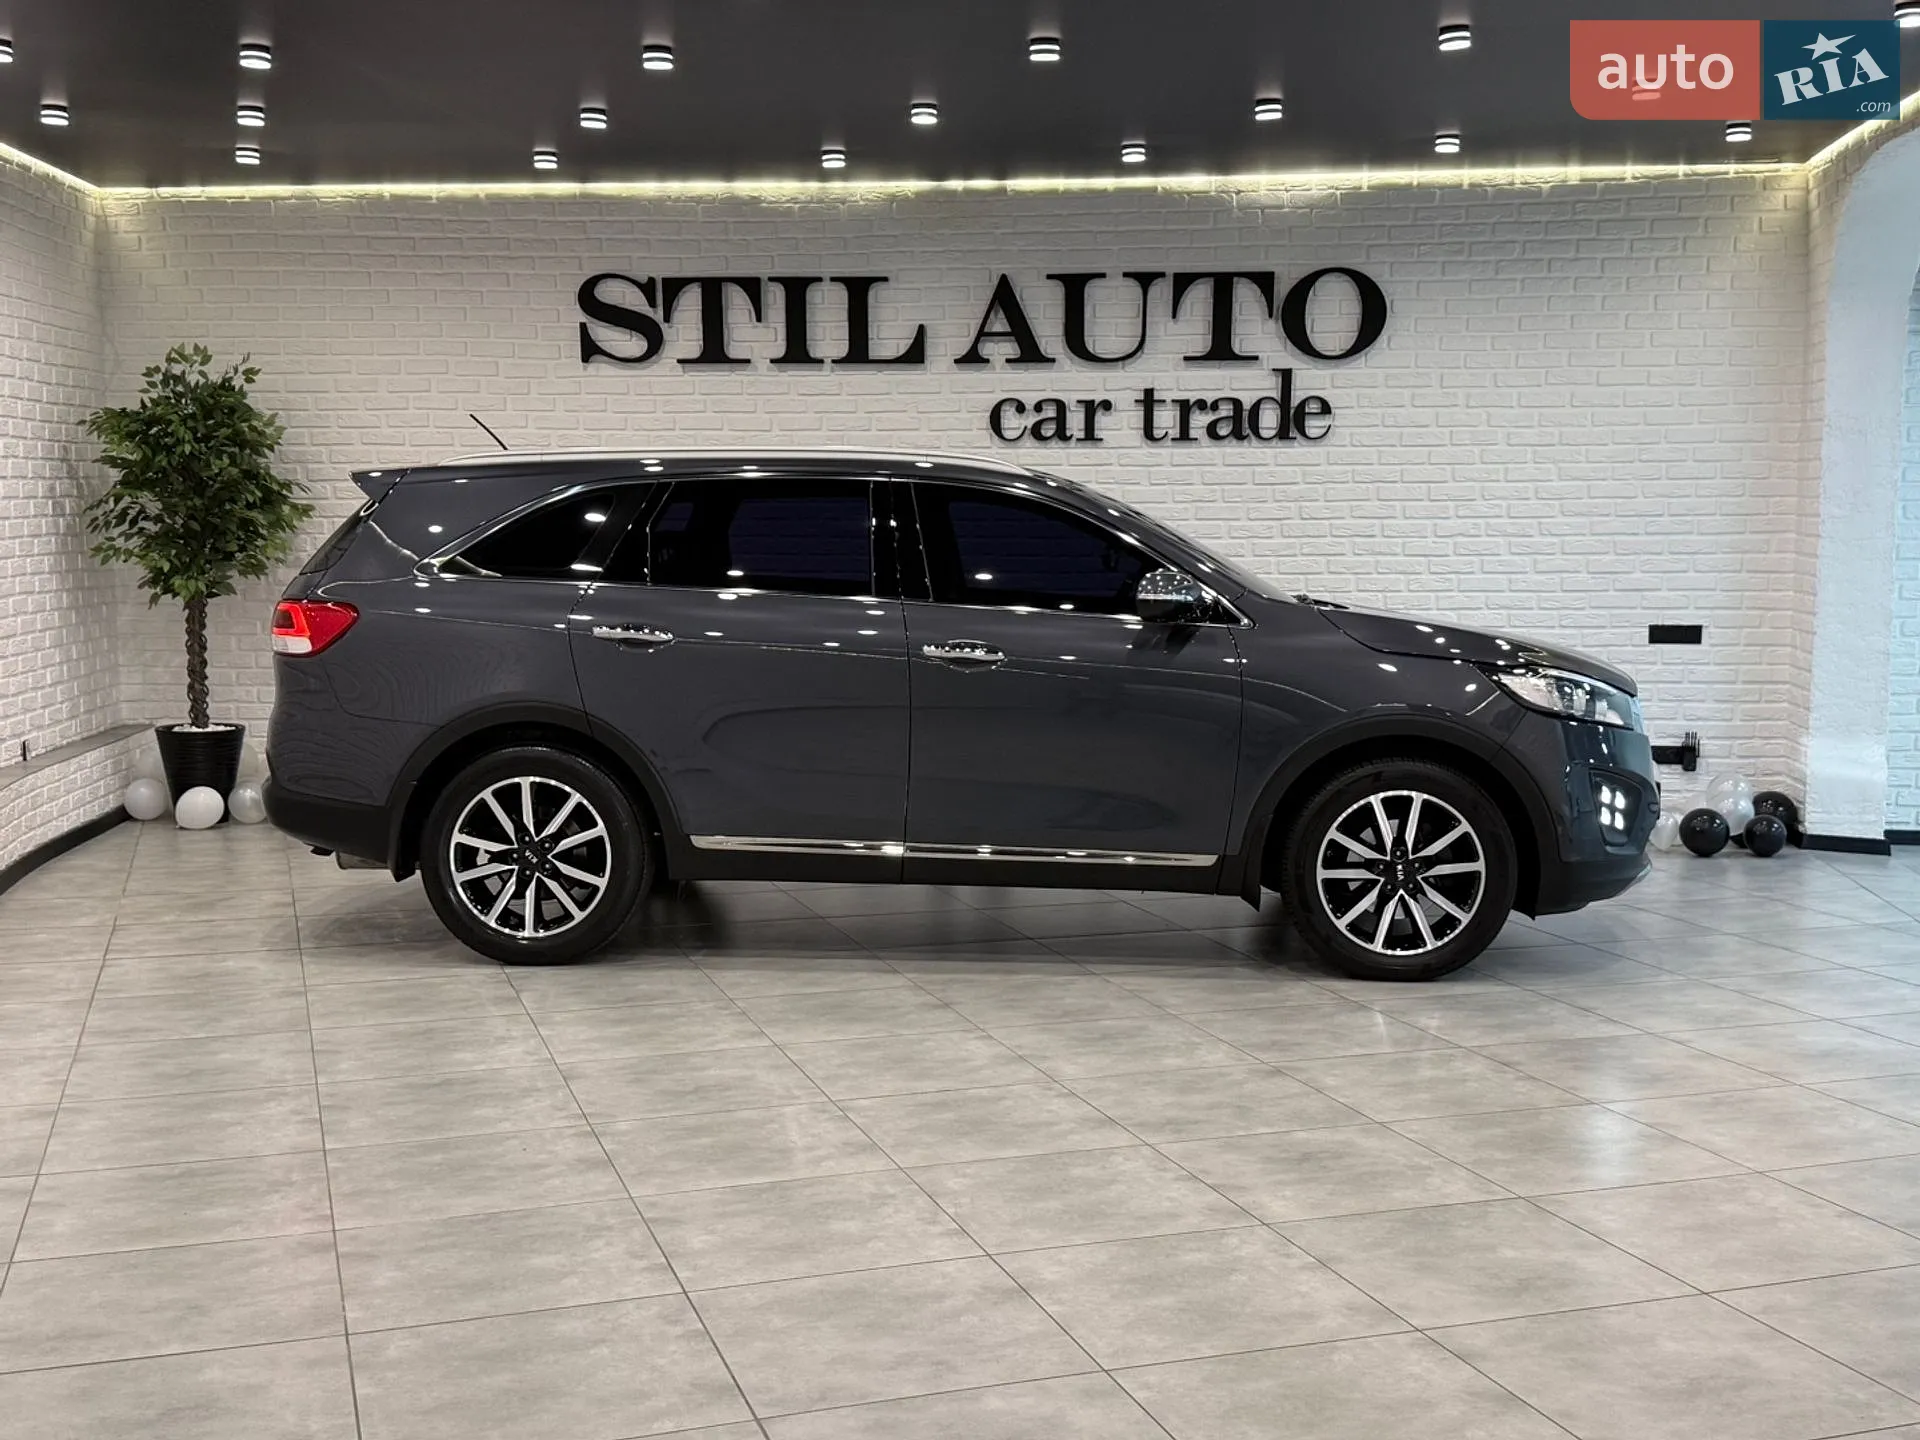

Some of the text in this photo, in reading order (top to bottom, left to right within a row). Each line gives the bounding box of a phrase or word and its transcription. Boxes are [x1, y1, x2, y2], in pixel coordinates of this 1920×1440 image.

[578, 267, 1388, 365] STIL AUTO
[989, 367, 1332, 442] car trade
